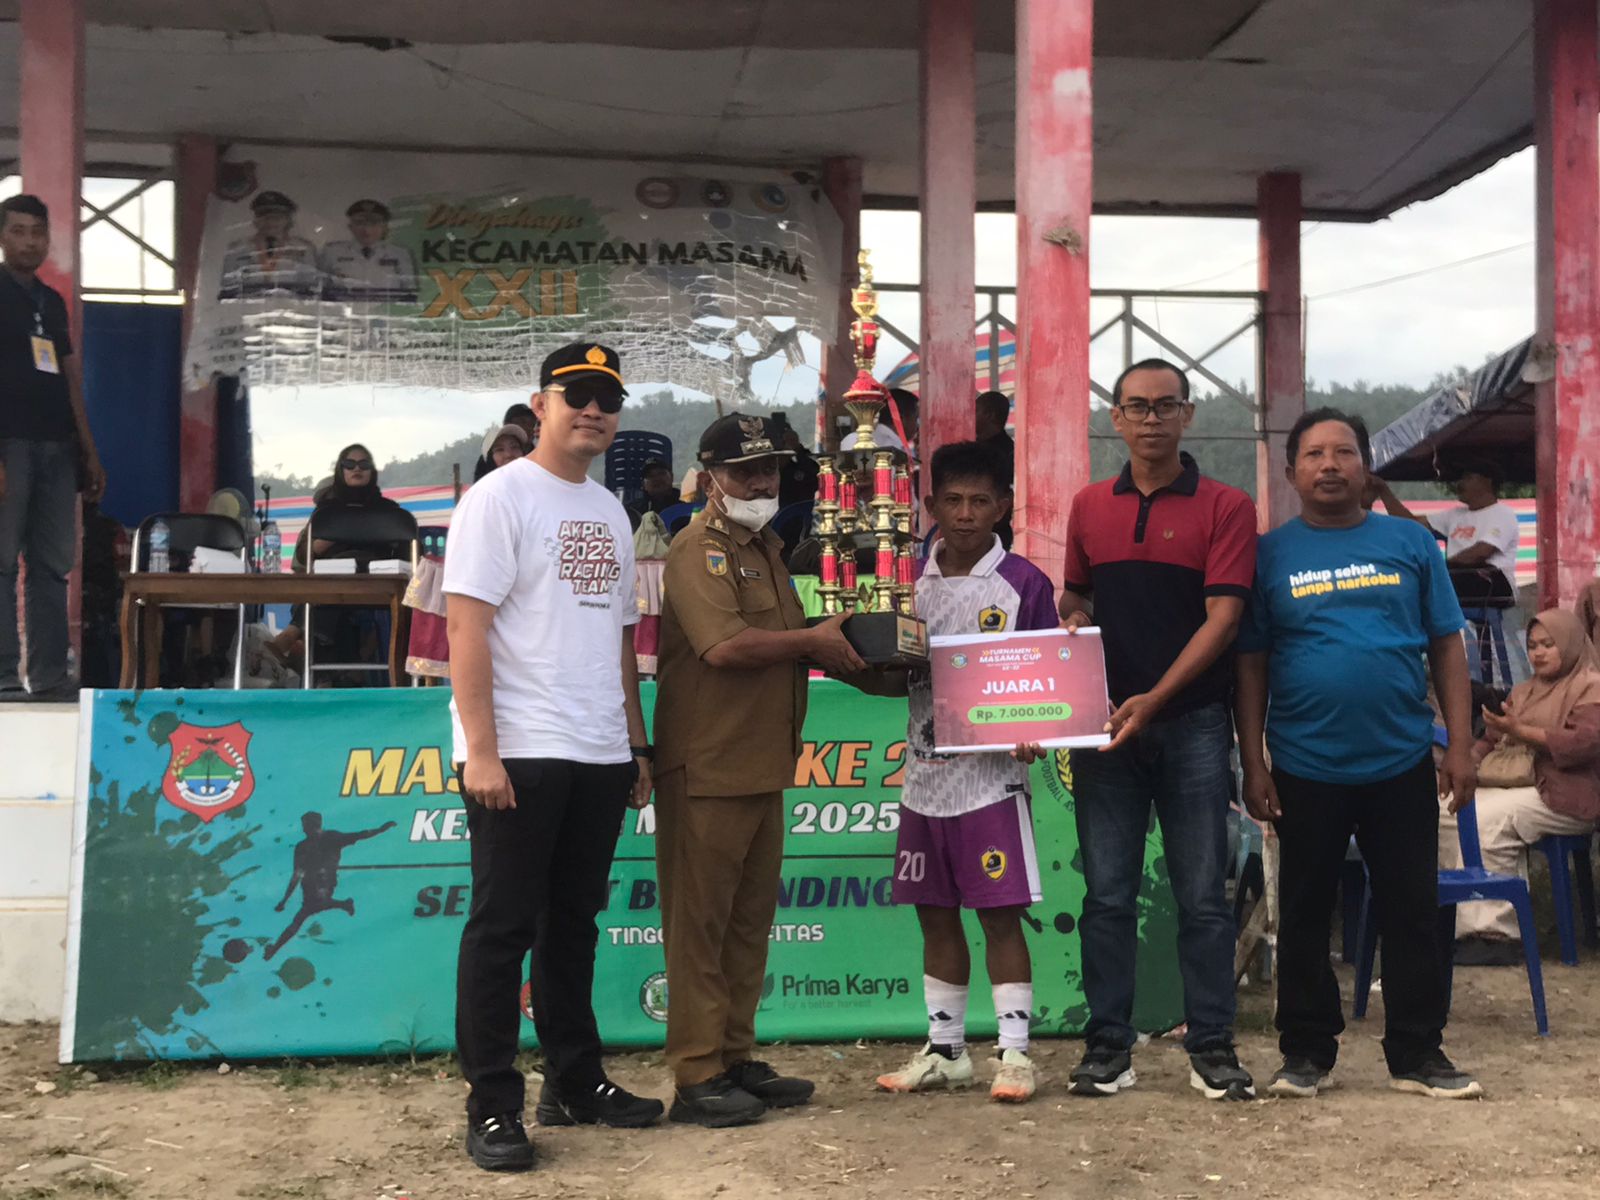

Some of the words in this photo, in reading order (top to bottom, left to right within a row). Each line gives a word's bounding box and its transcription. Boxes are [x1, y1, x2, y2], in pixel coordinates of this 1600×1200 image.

[422, 239, 647, 264] KECAMATAN
[657, 241, 808, 282] MASAMA
[420, 267, 578, 320] XXII
[558, 520, 614, 540] AKPOL
[561, 539, 616, 561] 2022
[559, 560, 621, 581] RACING
[1289, 569, 1332, 587] hidup
[1334, 563, 1376, 579] sehat
[1291, 581, 1334, 598] tanpa
[979, 654, 1021, 664] MASAMA
[1022, 653, 1042, 662] CUP
[982, 679, 1045, 695] JUARA
[1047, 677, 1056, 692] 1
[976, 709, 997, 722] Rp.
[1000, 706, 1064, 719] 7.000.000
[793, 740, 873, 788] KE
[408, 807, 471, 843] KE
[789, 801, 901, 835] 2025
[897, 850, 926, 883] 20
[413, 884, 472, 919] SE
[607, 926, 663, 945] TING
[782, 973, 840, 997] Prima
[846, 973, 910, 999] Karya
